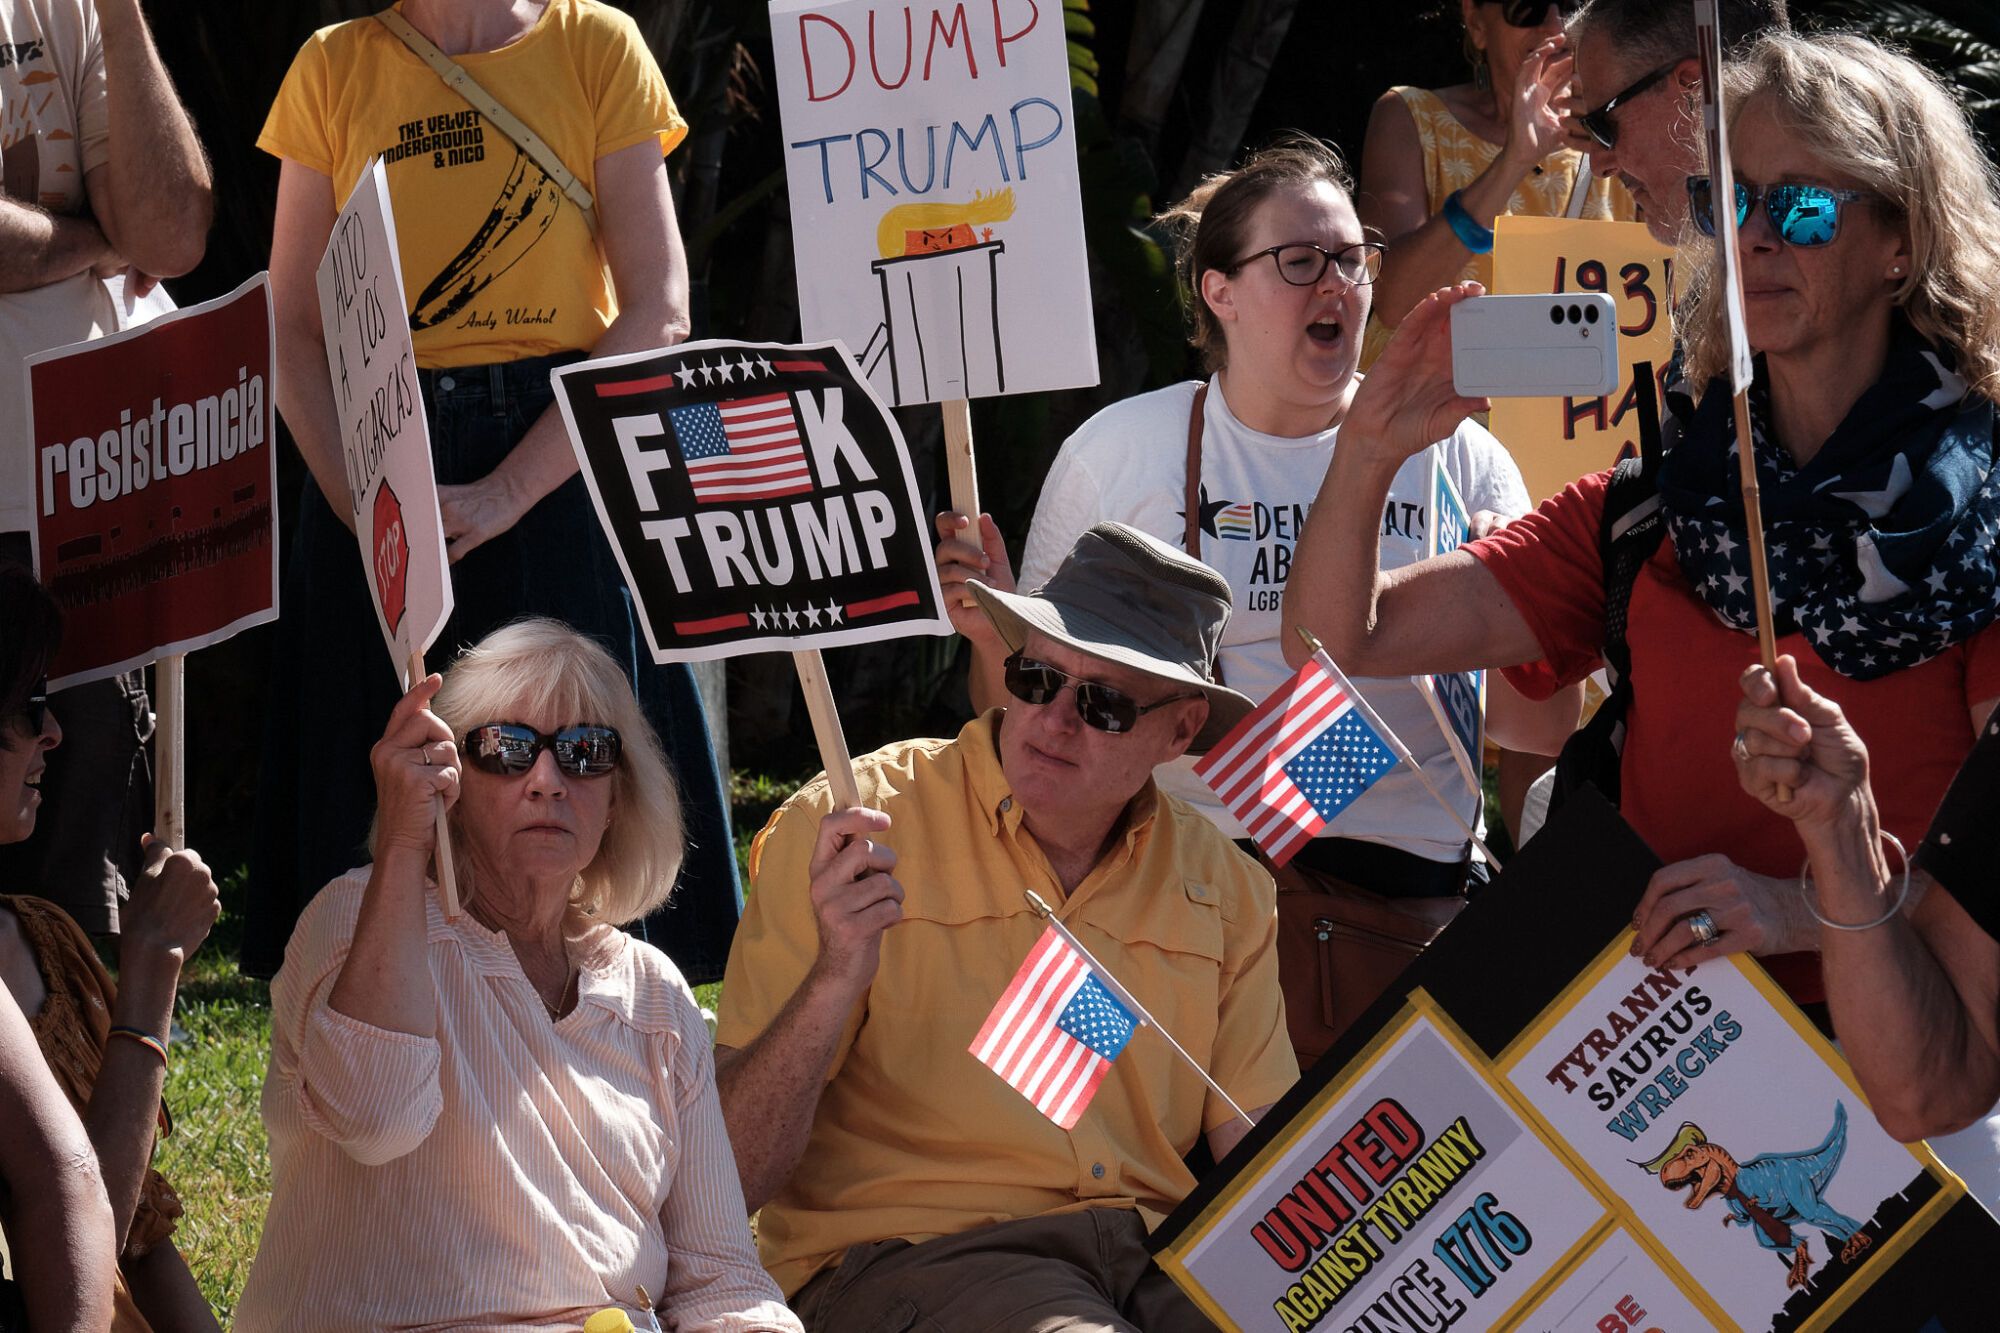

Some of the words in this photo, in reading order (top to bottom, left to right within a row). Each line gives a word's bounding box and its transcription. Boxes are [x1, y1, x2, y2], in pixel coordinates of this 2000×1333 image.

[799, 0, 1039, 102] DUMP
[379, 127, 484, 167] NDERGROUND
[398, 120, 424, 142] THE
[427, 110, 482, 132] VELVET
[433, 151, 445, 169] &
[449, 145, 485, 167] NICO
[791, 97, 1063, 204] TRUMP
[332, 211, 367, 334] ALTO
[456, 311, 497, 329] Andy
[505, 308, 557, 326] Warhol
[339, 343, 352, 412] A
[357, 275, 385, 368] LOS
[41, 365, 264, 517] resistencia
[348, 352, 413, 516] OLIGARCAS
[378, 520, 401, 605] STOP
[640, 489, 897, 594] TRUMP
[1249, 590, 1284, 612] LGB
[1545, 965, 1698, 1094] TYRANN
[1588, 986, 1713, 1112] SAURUS
[1606, 1010, 1743, 1143] WRECKS
[1250, 1097, 1426, 1273] UNITED
[1273, 1219, 1385, 1333] AGAINST
[1362, 1115, 1487, 1245] TYRANNY
[1432, 1191, 1533, 1299] 1776
